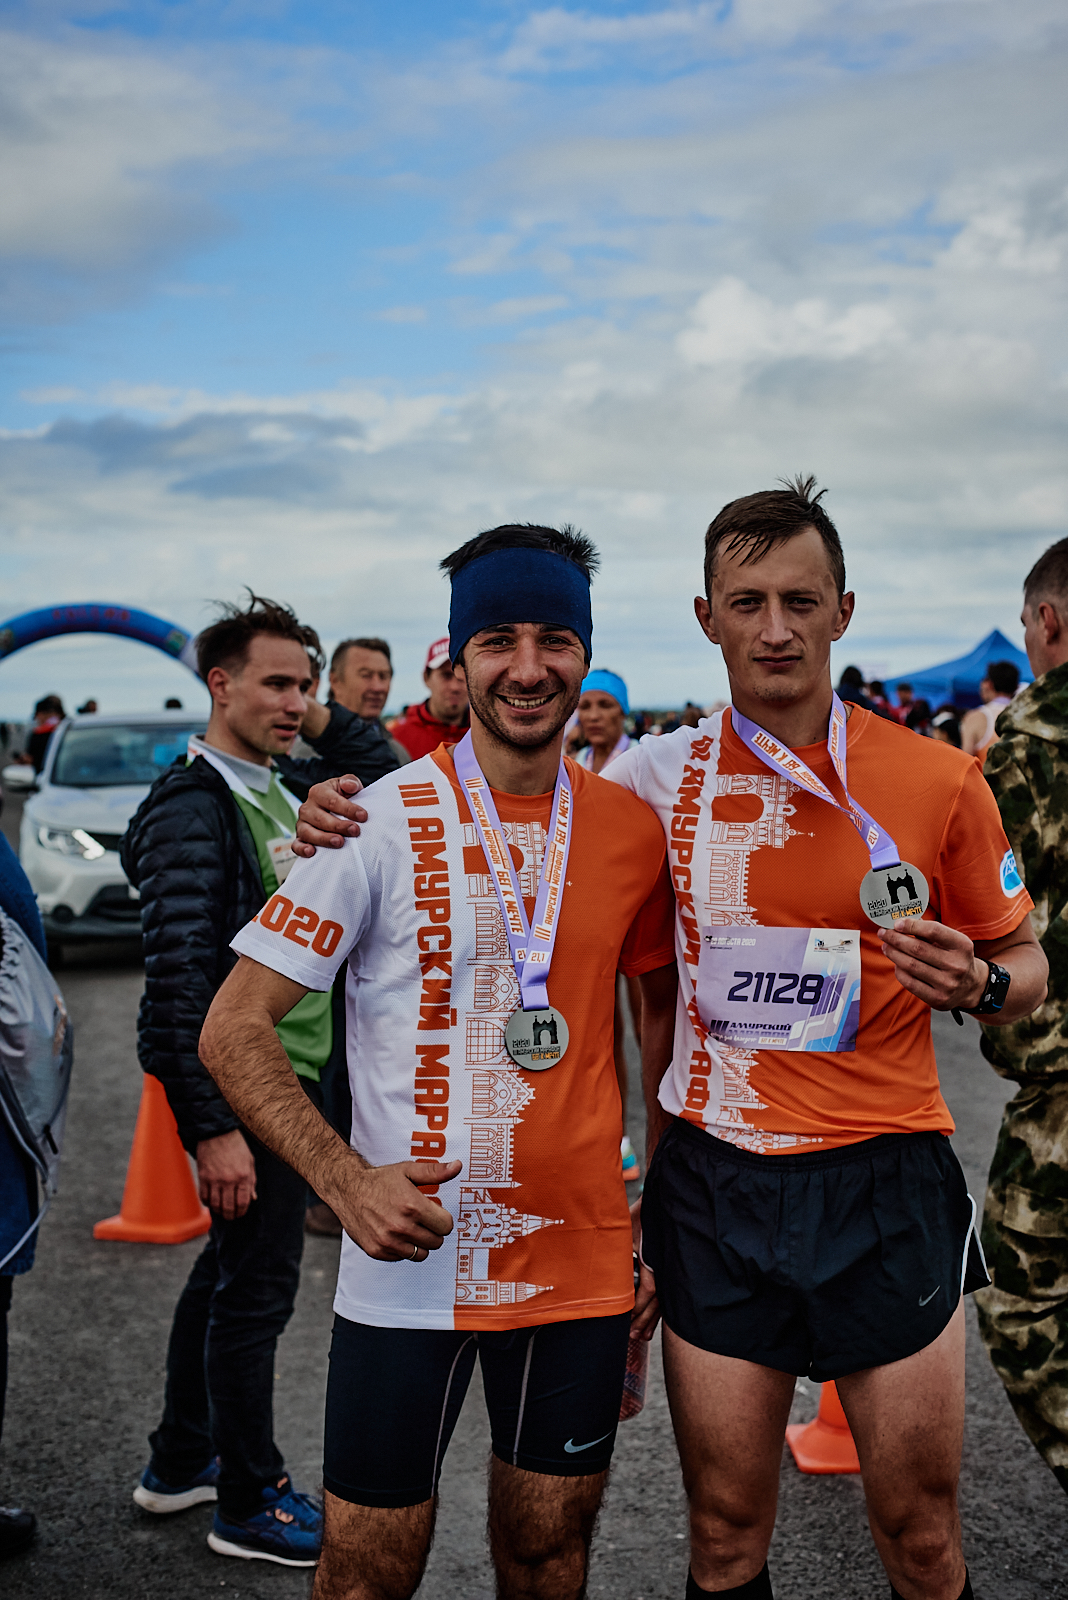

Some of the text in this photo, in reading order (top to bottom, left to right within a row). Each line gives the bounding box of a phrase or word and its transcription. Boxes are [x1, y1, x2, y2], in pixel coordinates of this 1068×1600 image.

[754, 732, 779, 757] МЕЧТЕ
[776, 752, 787, 762] К
[783, 759, 801, 771] БЕГ
[558, 787, 570, 819] МЕЧТЕ
[557, 818, 568, 828] К
[555, 827, 567, 846] БЕГ
[496, 871, 512, 888] БЕГ
[502, 890, 515, 898] К
[868, 899, 887, 910] 2020
[505, 900, 524, 934] МЕЧТЕ
[252, 894, 344, 957] 020
[408, 817, 457, 1030] АМУРСКИЙ
[741, 938, 756, 946] 2020
[531, 952, 545, 963] 21,1
[727, 971, 824, 1005] 21128
[730, 1022, 791, 1031] АМУРСКИЙ
[513, 1038, 530, 1048] 2020
